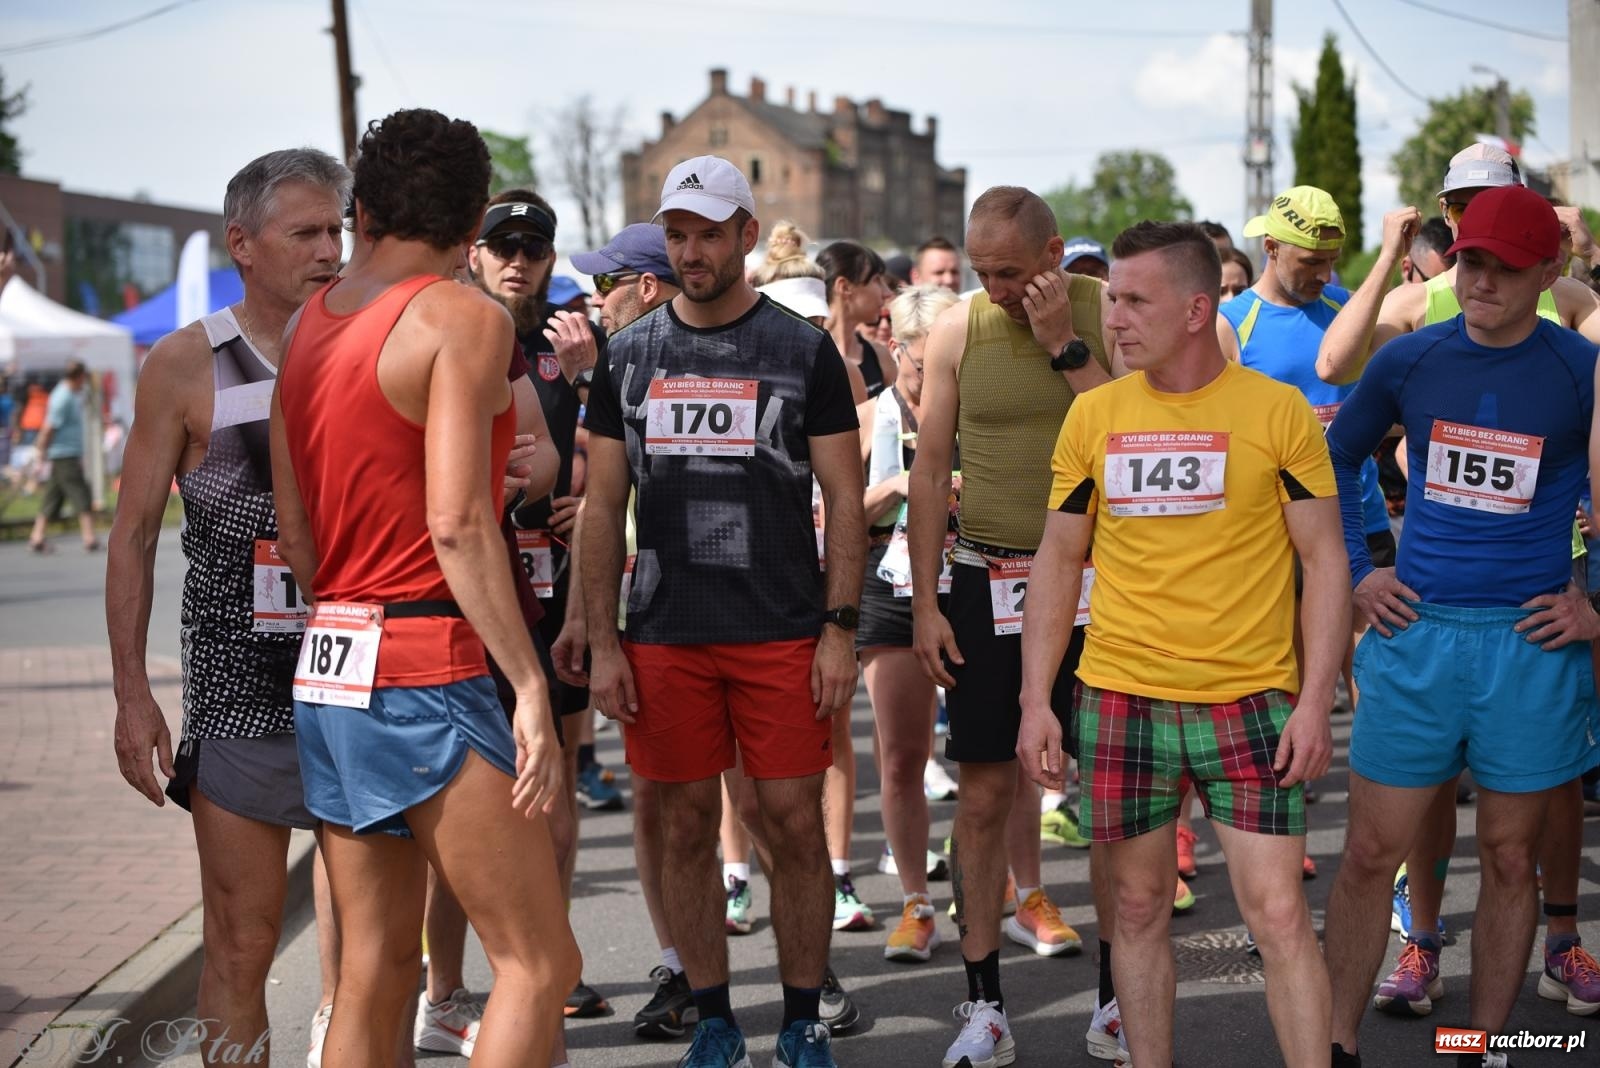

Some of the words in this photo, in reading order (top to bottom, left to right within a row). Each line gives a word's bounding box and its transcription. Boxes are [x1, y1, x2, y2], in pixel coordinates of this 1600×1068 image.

[676, 183, 704, 191] adidas
[677, 381, 695, 389] BIEG
[696, 381, 711, 389] BEZ
[671, 403, 733, 435] 170
[1121, 435, 1137, 443] XVI
[1138, 434, 1158, 442] BIEG
[1159, 434, 1176, 442] BEZ
[1177, 434, 1214, 442] GRANIC
[1442, 425, 1457, 434] XVI
[1457, 428, 1477, 437] BIEG
[1478, 431, 1495, 440] BEZ
[1495, 434, 1529, 446] GRANIC
[1128, 456, 1201, 493] 143
[1447, 449, 1516, 491] 155
[309, 634, 353, 677] 187
